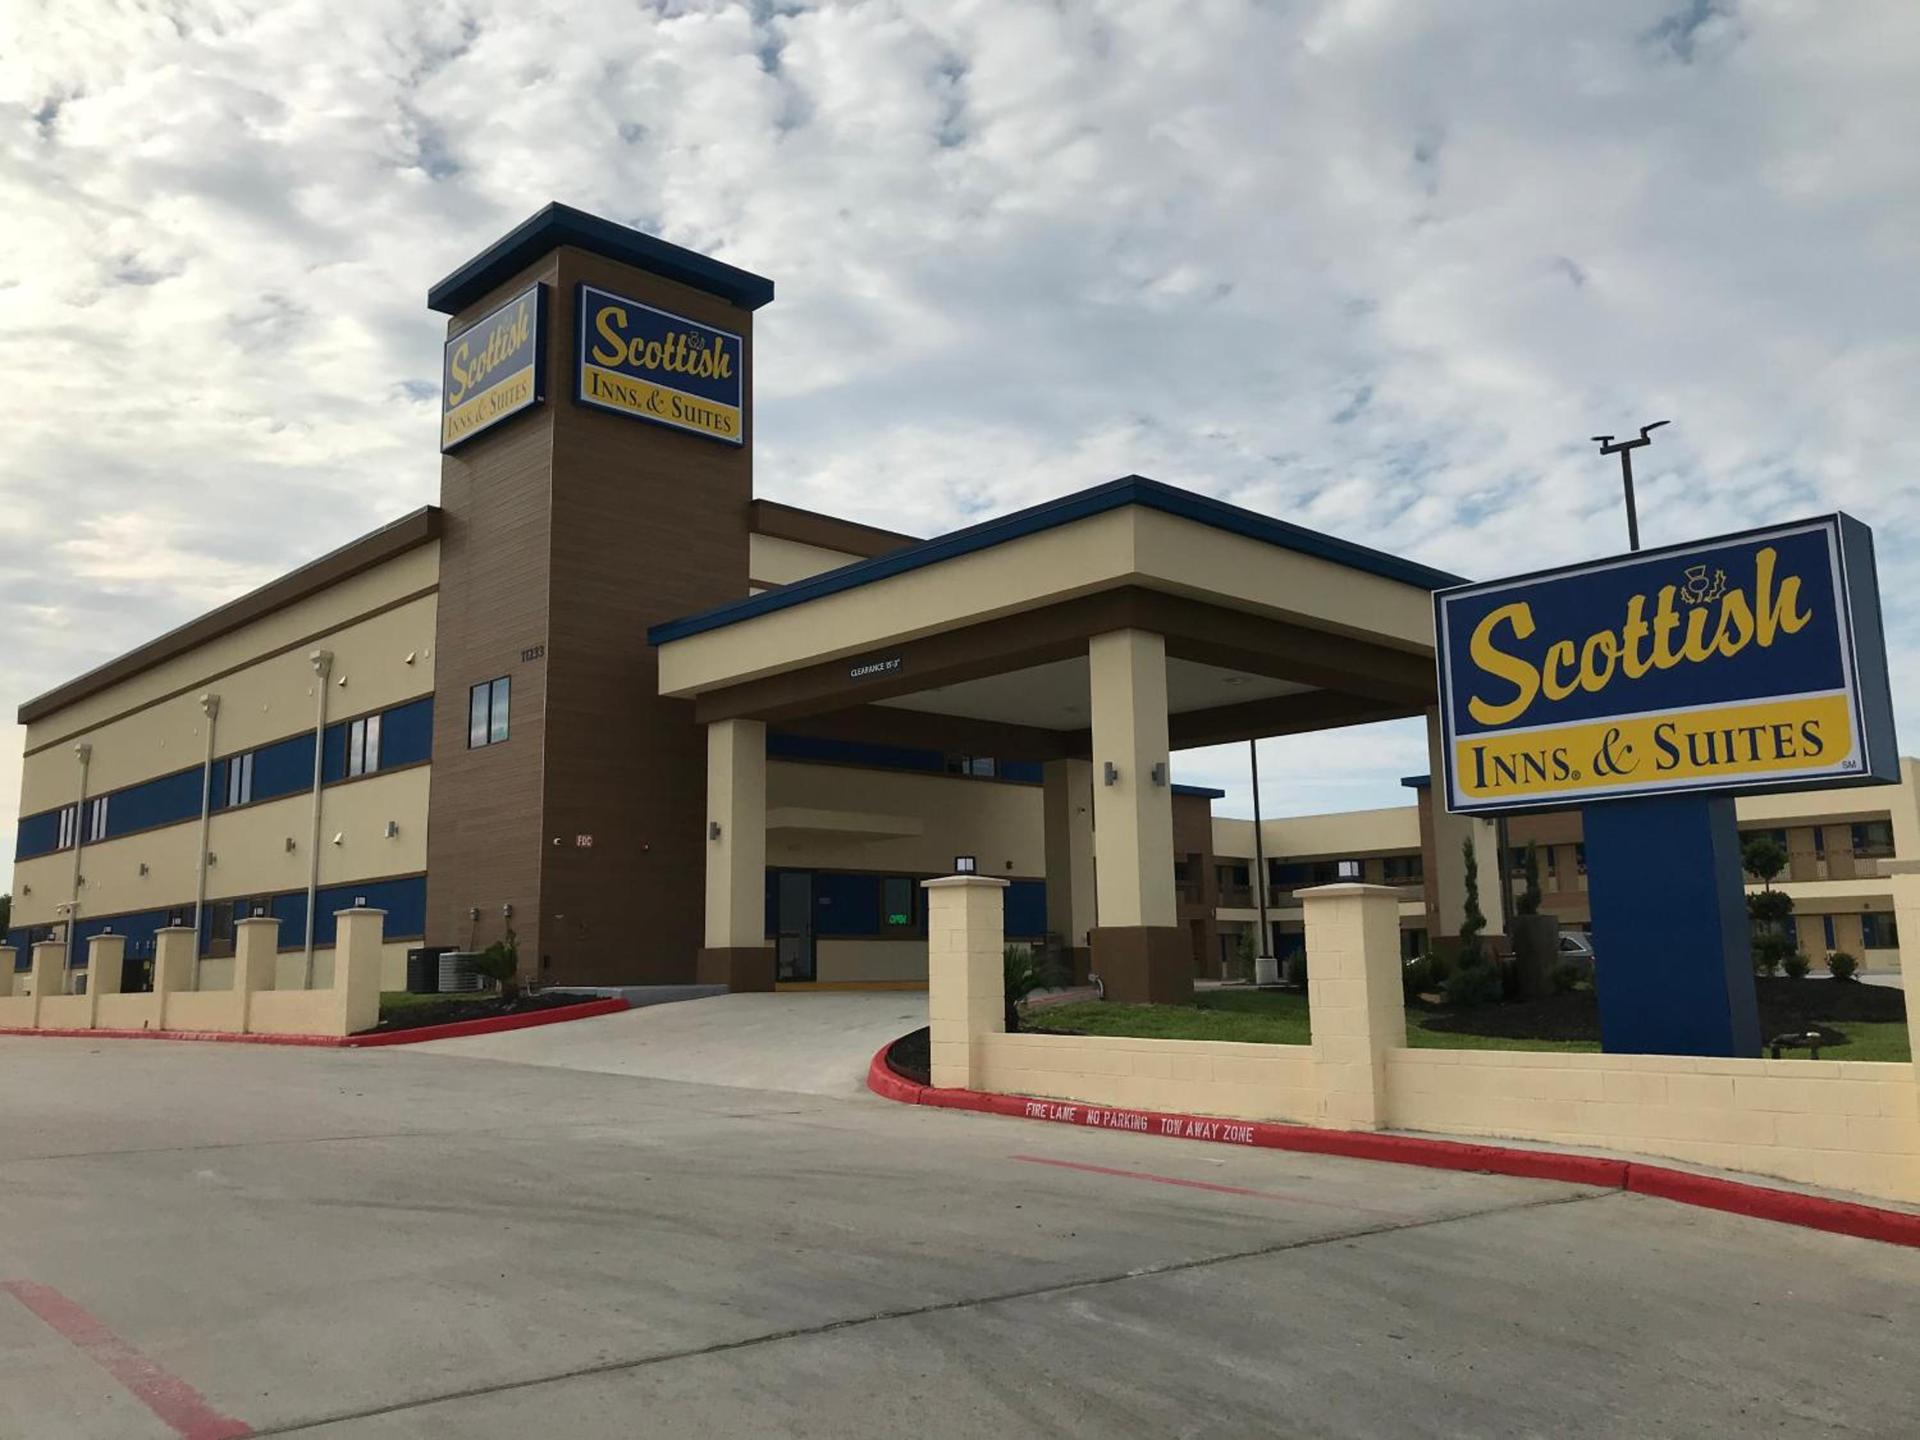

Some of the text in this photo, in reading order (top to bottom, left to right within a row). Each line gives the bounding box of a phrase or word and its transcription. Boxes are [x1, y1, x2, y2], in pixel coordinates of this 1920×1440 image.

[449, 301, 529, 406] Scottish
[592, 306, 732, 380] Scottish
[647, 389, 665, 415] &
[672, 396, 732, 433] SUITES
[1467, 546, 1812, 726] Scottish
[850, 662, 885, 677] CLEARANCE
[1593, 728, 1640, 778] &
[1653, 719, 1825, 771] SUITES
[888, 914, 908, 925] OPEN
[1025, 1102, 1254, 1143] FIRE LANE NO PARKING TOW AWAY ZONE
